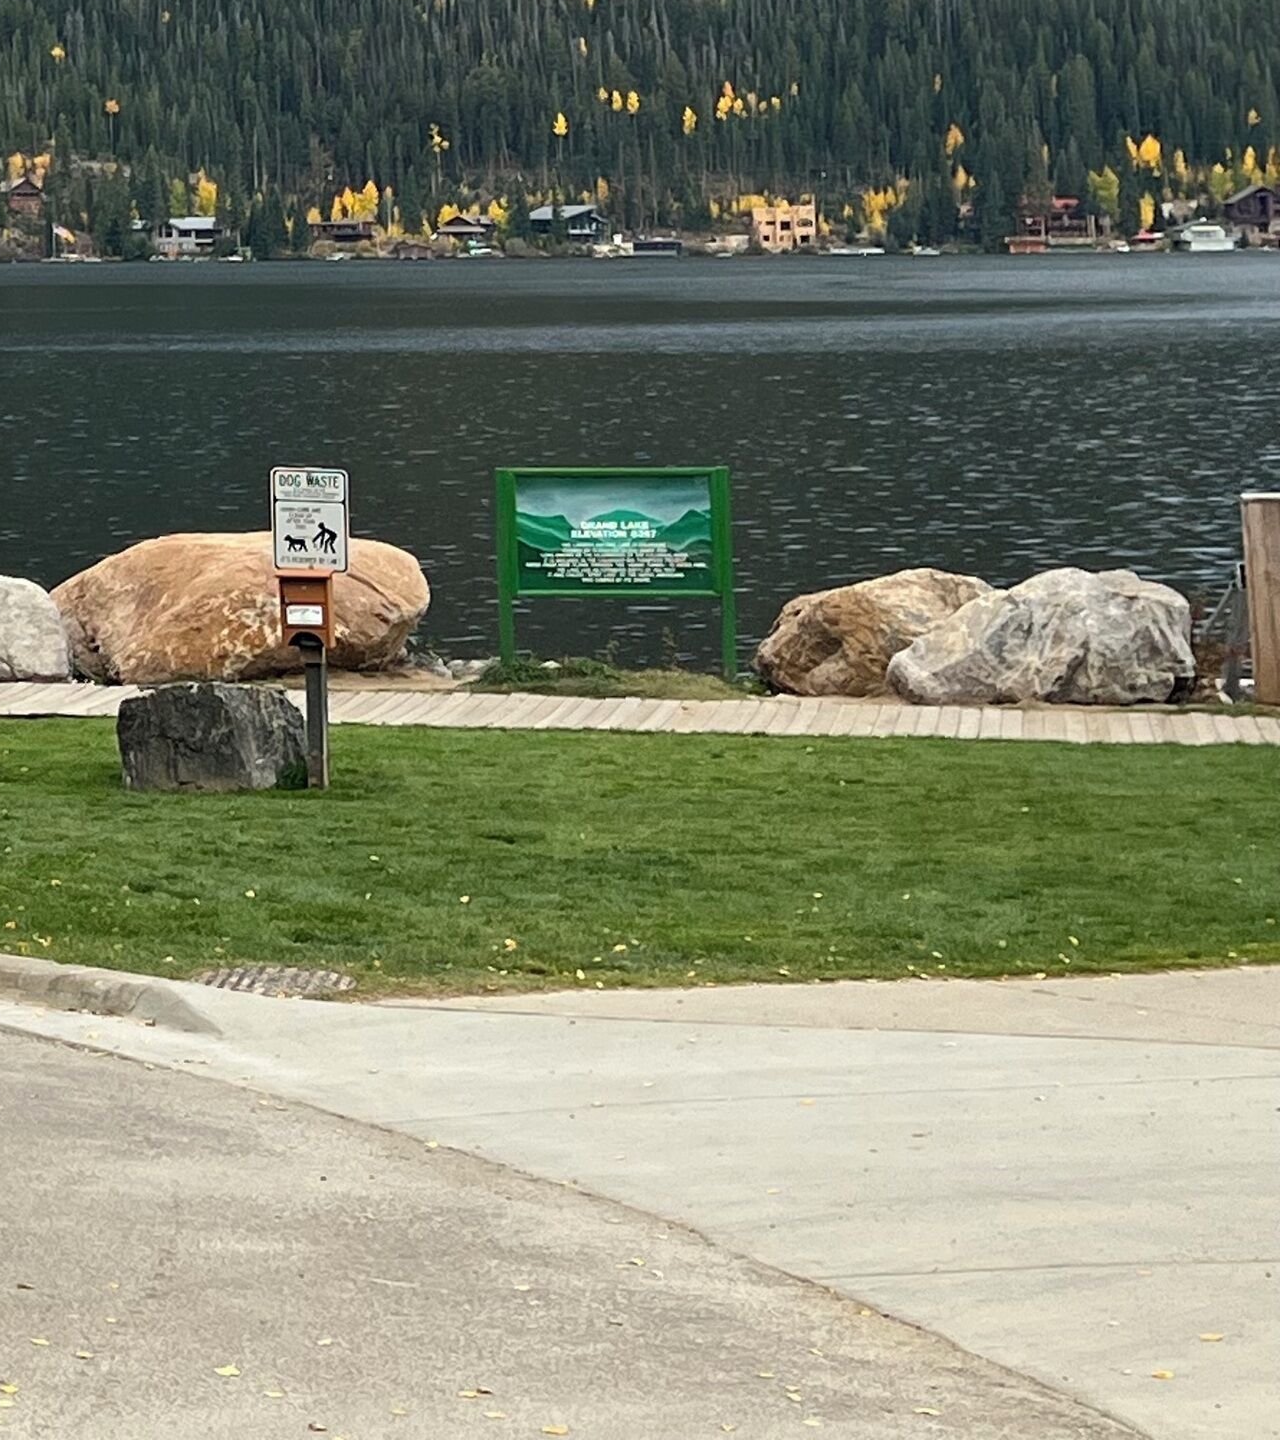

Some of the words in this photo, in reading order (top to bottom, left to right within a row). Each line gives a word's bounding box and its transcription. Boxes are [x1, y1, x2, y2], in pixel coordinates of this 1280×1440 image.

[278, 474, 301, 487] DOG
[306, 475, 340, 489] WASTE
[620, 521, 649, 530] LAKE
[570, 530, 627, 539] ELEVATION
